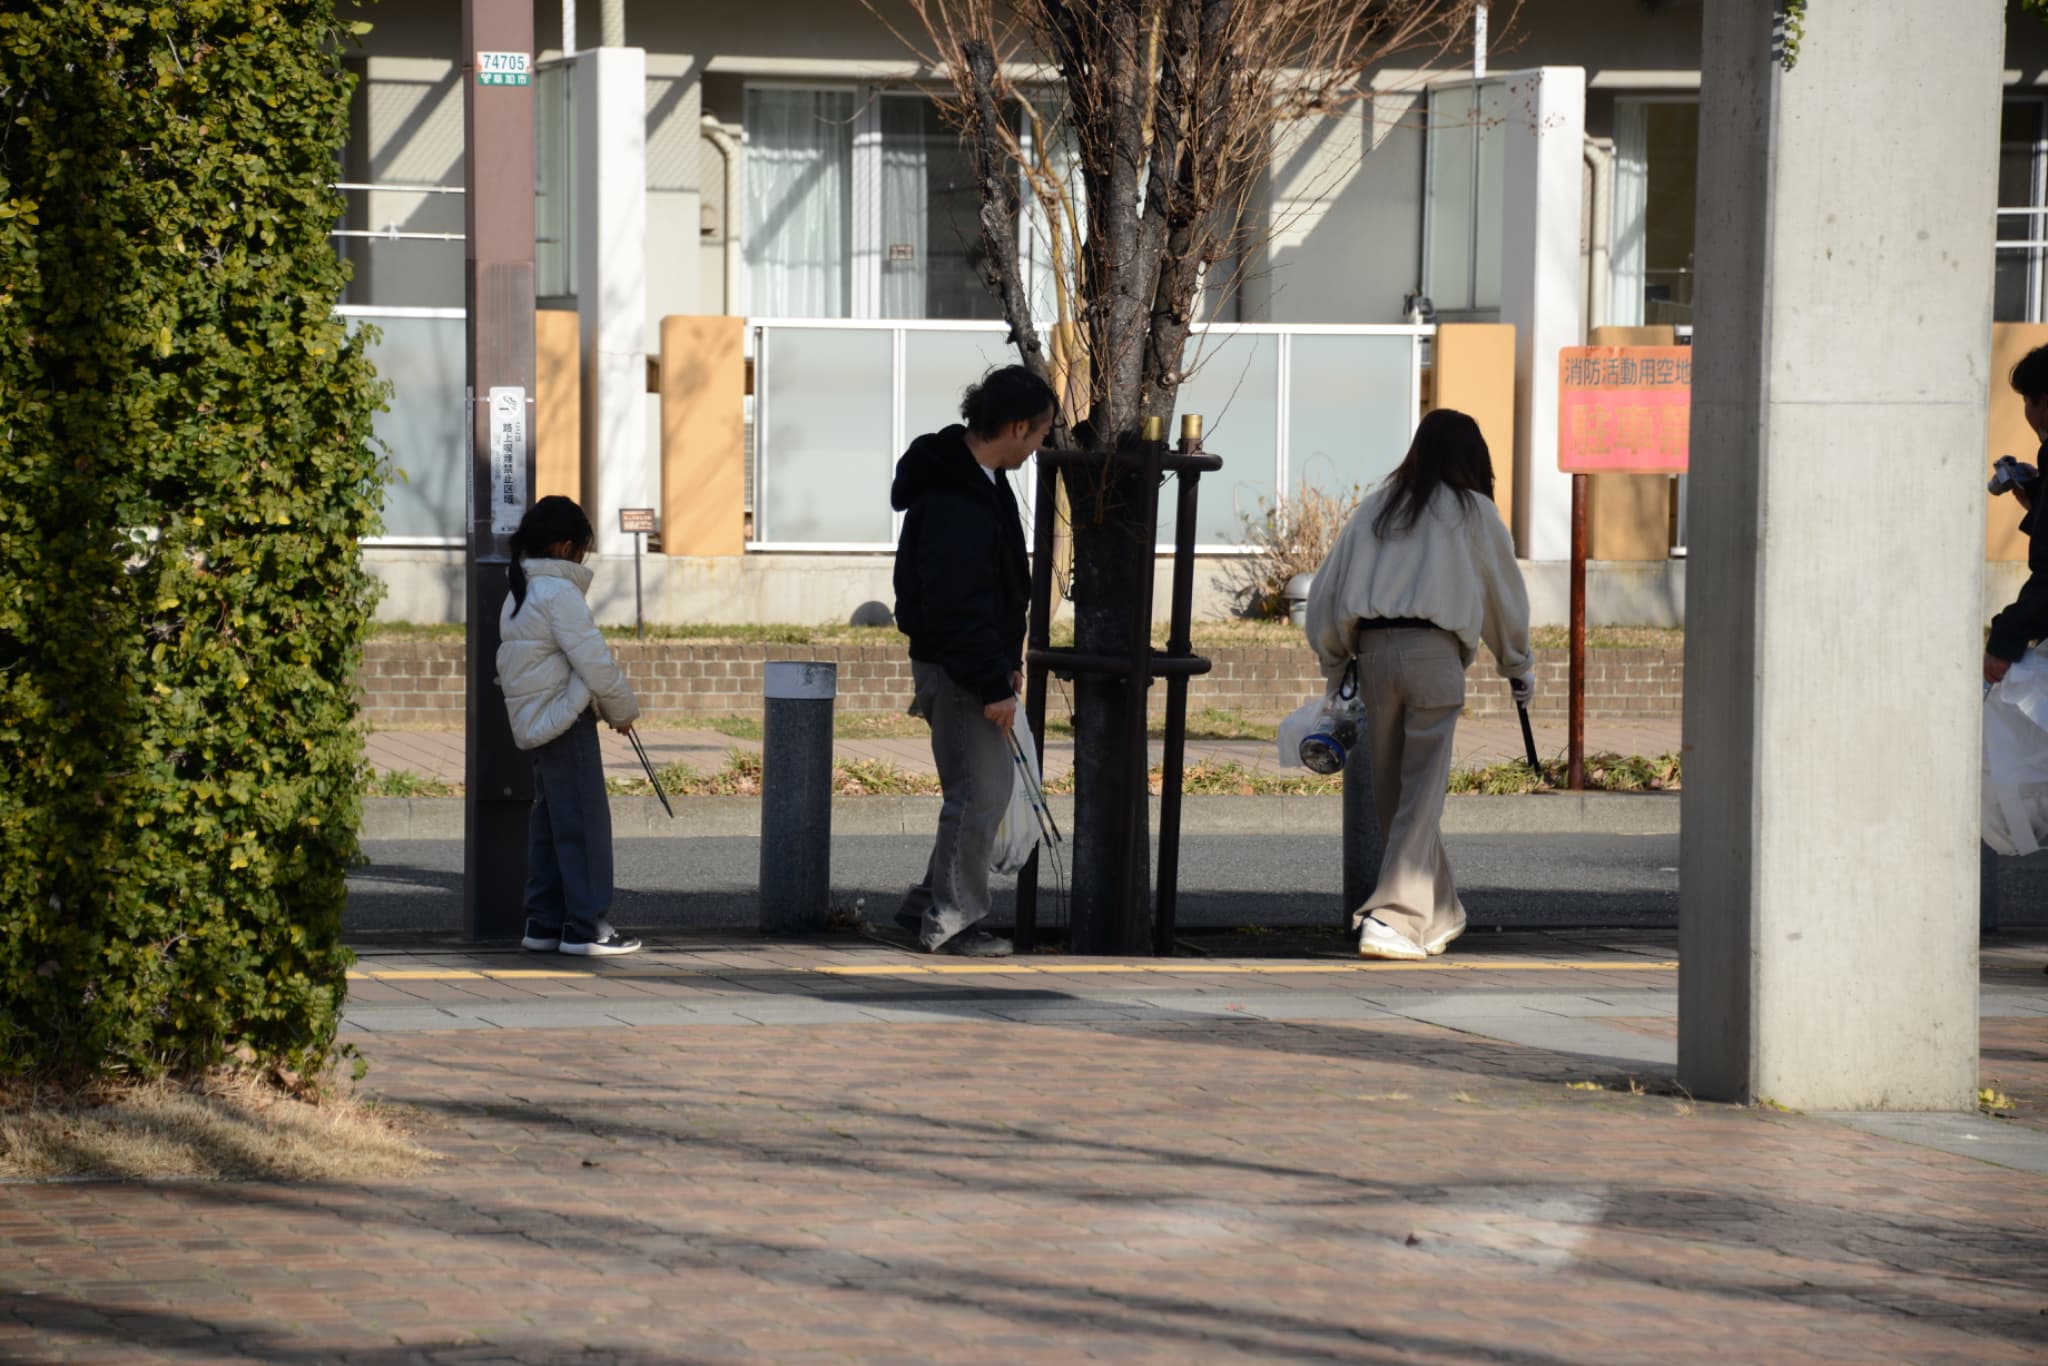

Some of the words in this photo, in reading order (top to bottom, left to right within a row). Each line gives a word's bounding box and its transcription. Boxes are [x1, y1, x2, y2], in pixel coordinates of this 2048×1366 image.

[483, 54, 525, 70] 74705
[1565, 357, 1691, 386] 消防活動用空地
[503, 423, 513, 505] 路上喫煙禁止区域
